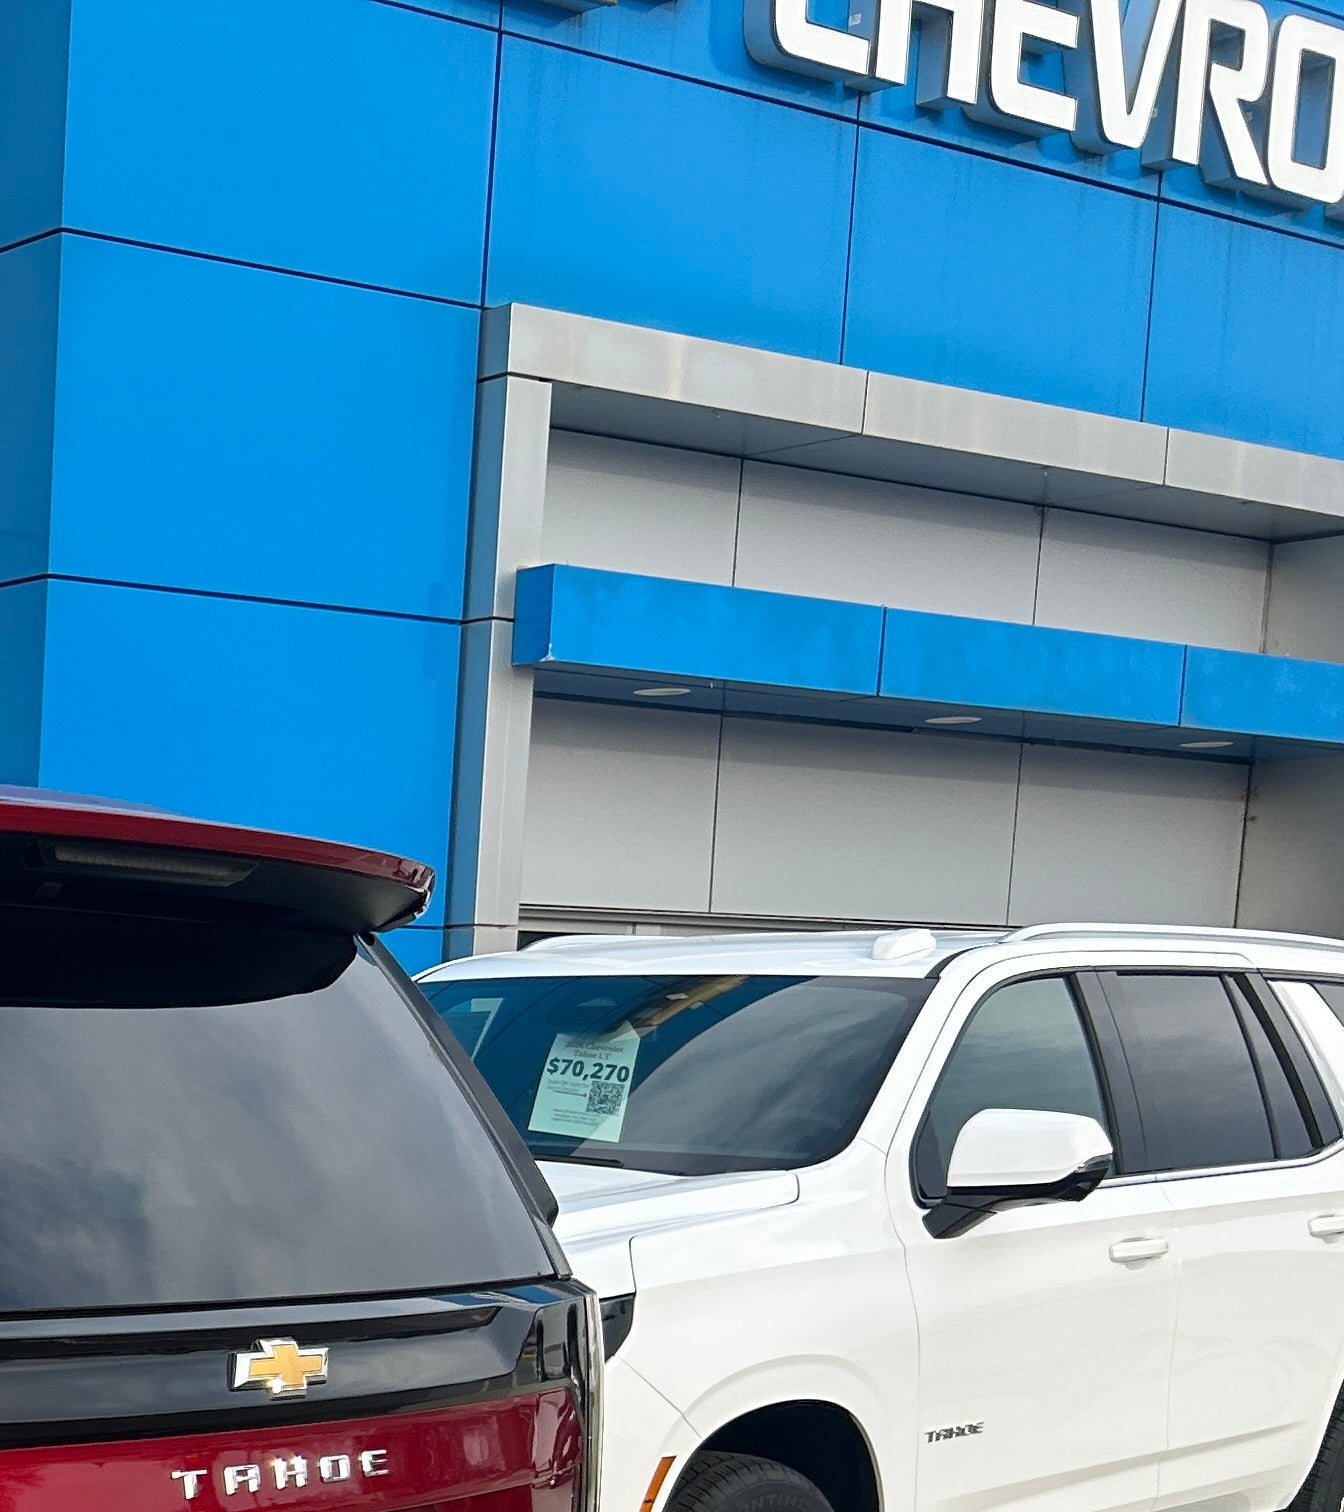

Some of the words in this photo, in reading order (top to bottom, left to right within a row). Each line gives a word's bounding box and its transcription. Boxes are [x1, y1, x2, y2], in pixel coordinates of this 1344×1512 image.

[547, 1057, 630, 1083] $70,270
[924, 1421, 984, 1443] TAHOE
[171, 1449, 390, 1500] TAHOE
